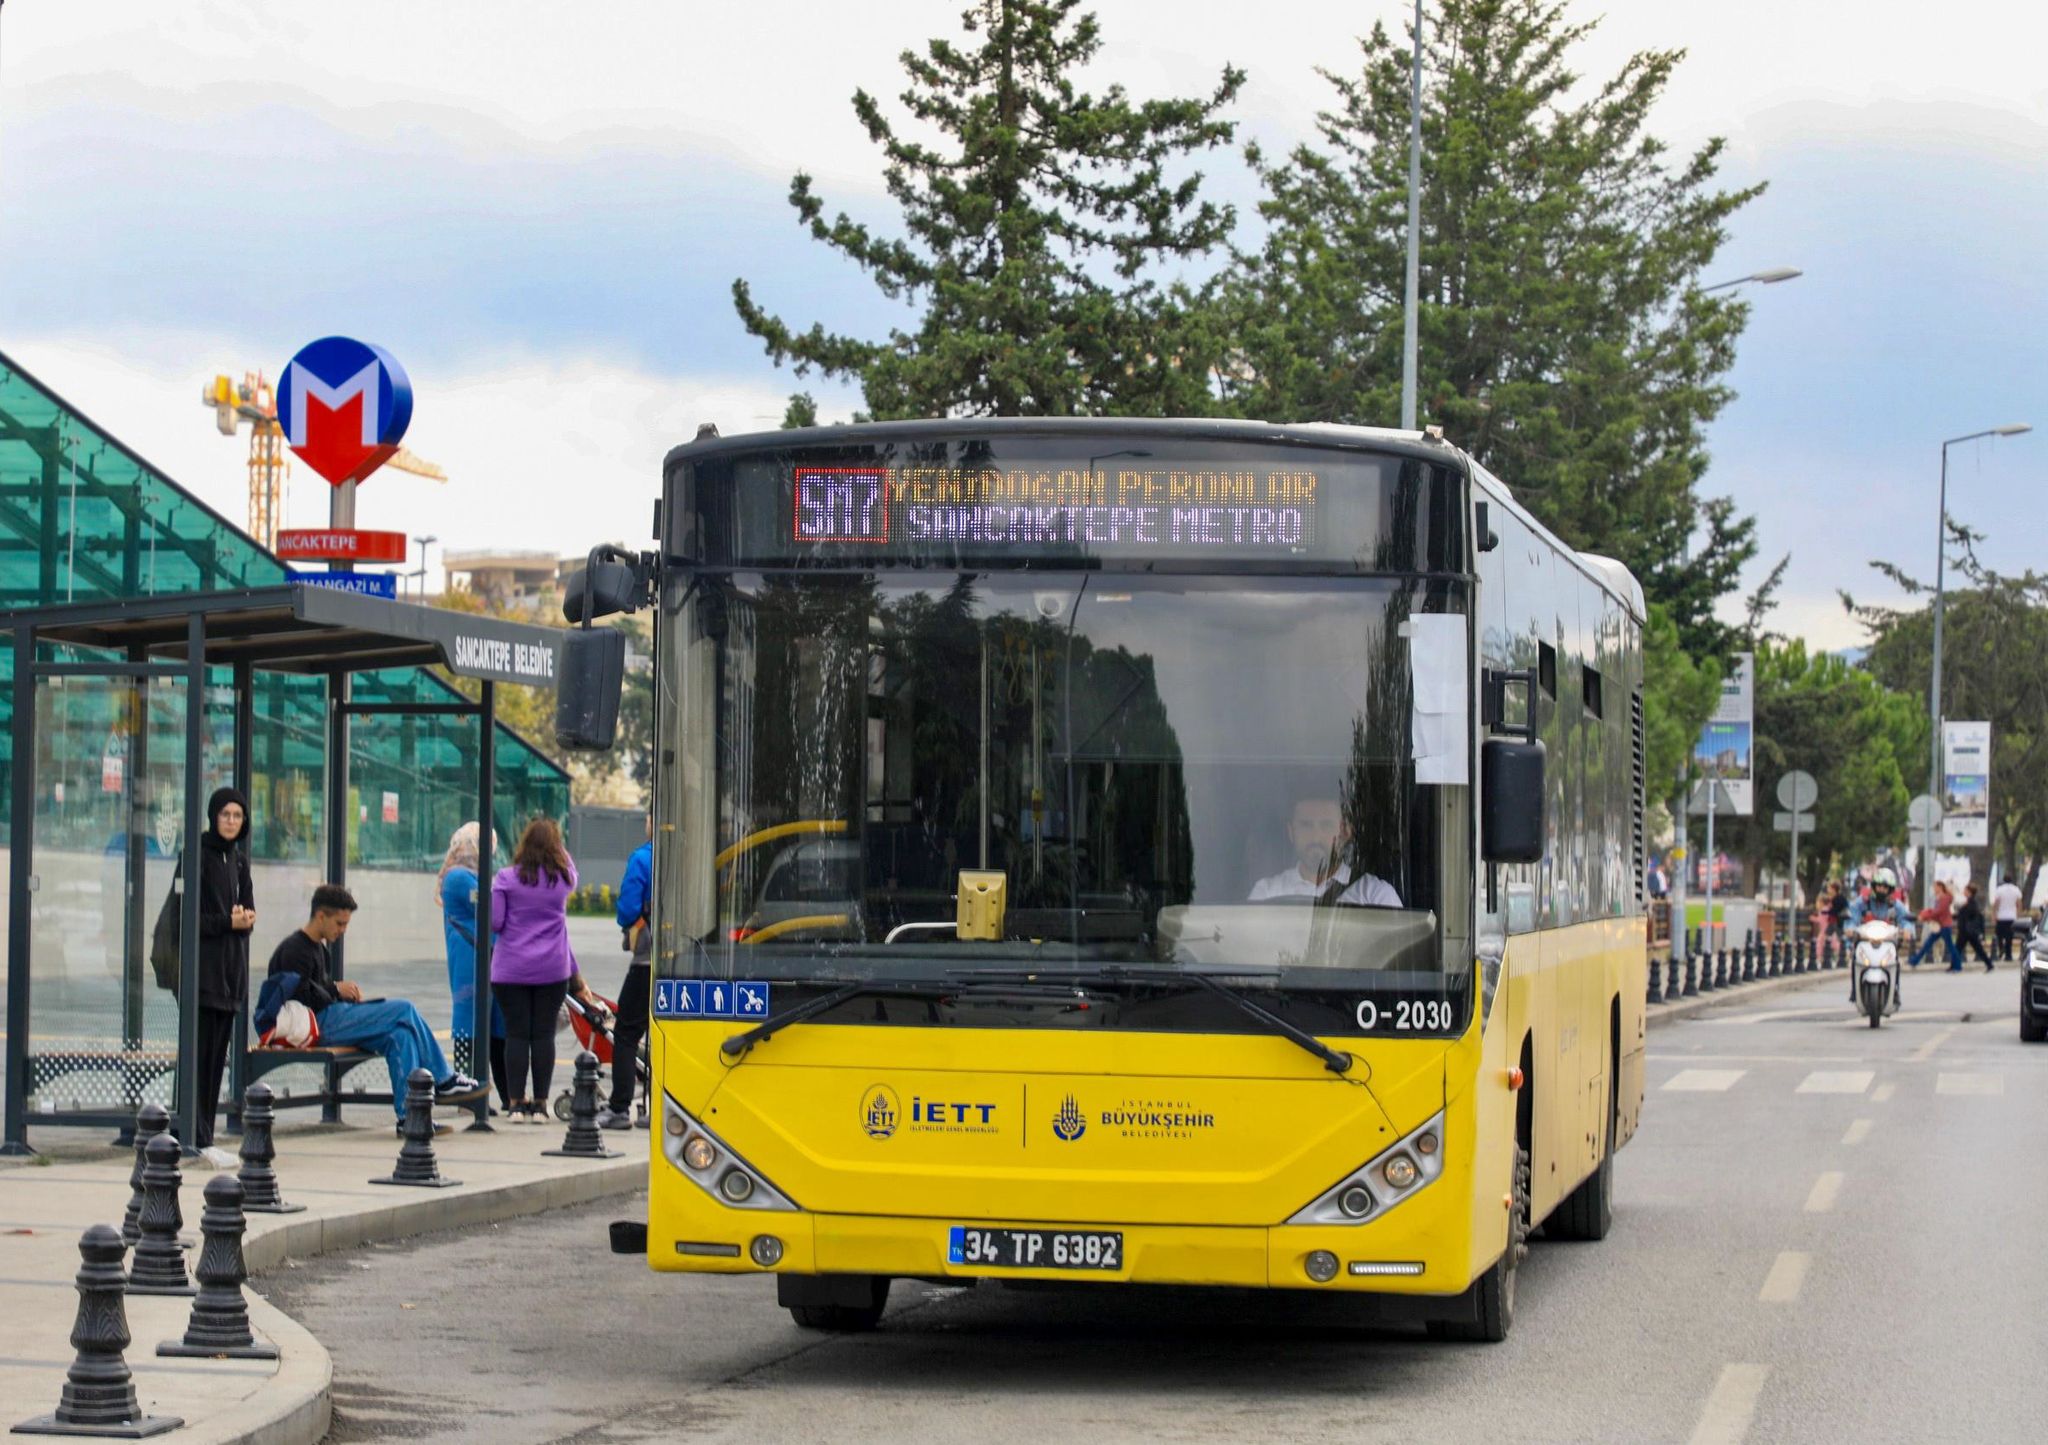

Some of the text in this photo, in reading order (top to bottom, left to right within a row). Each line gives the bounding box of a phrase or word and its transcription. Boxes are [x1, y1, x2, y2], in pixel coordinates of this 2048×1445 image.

[801, 475, 878, 535] SM7
[1118, 471, 1316, 505] PERONLAR
[909, 506, 1301, 543] SANCAKTEPE METRO
[456, 635, 553, 677] SANCAKTEPE BELEDİYE
[1357, 1000, 1452, 1030] O-2030
[912, 1097, 996, 1123] İETT
[1101, 1108, 1215, 1129] BÜYÜKŞEHİR
[966, 1230, 998, 1262] 34
[1011, 1233, 1043, 1264] TP
[1053, 1234, 1118, 1266] 6382
